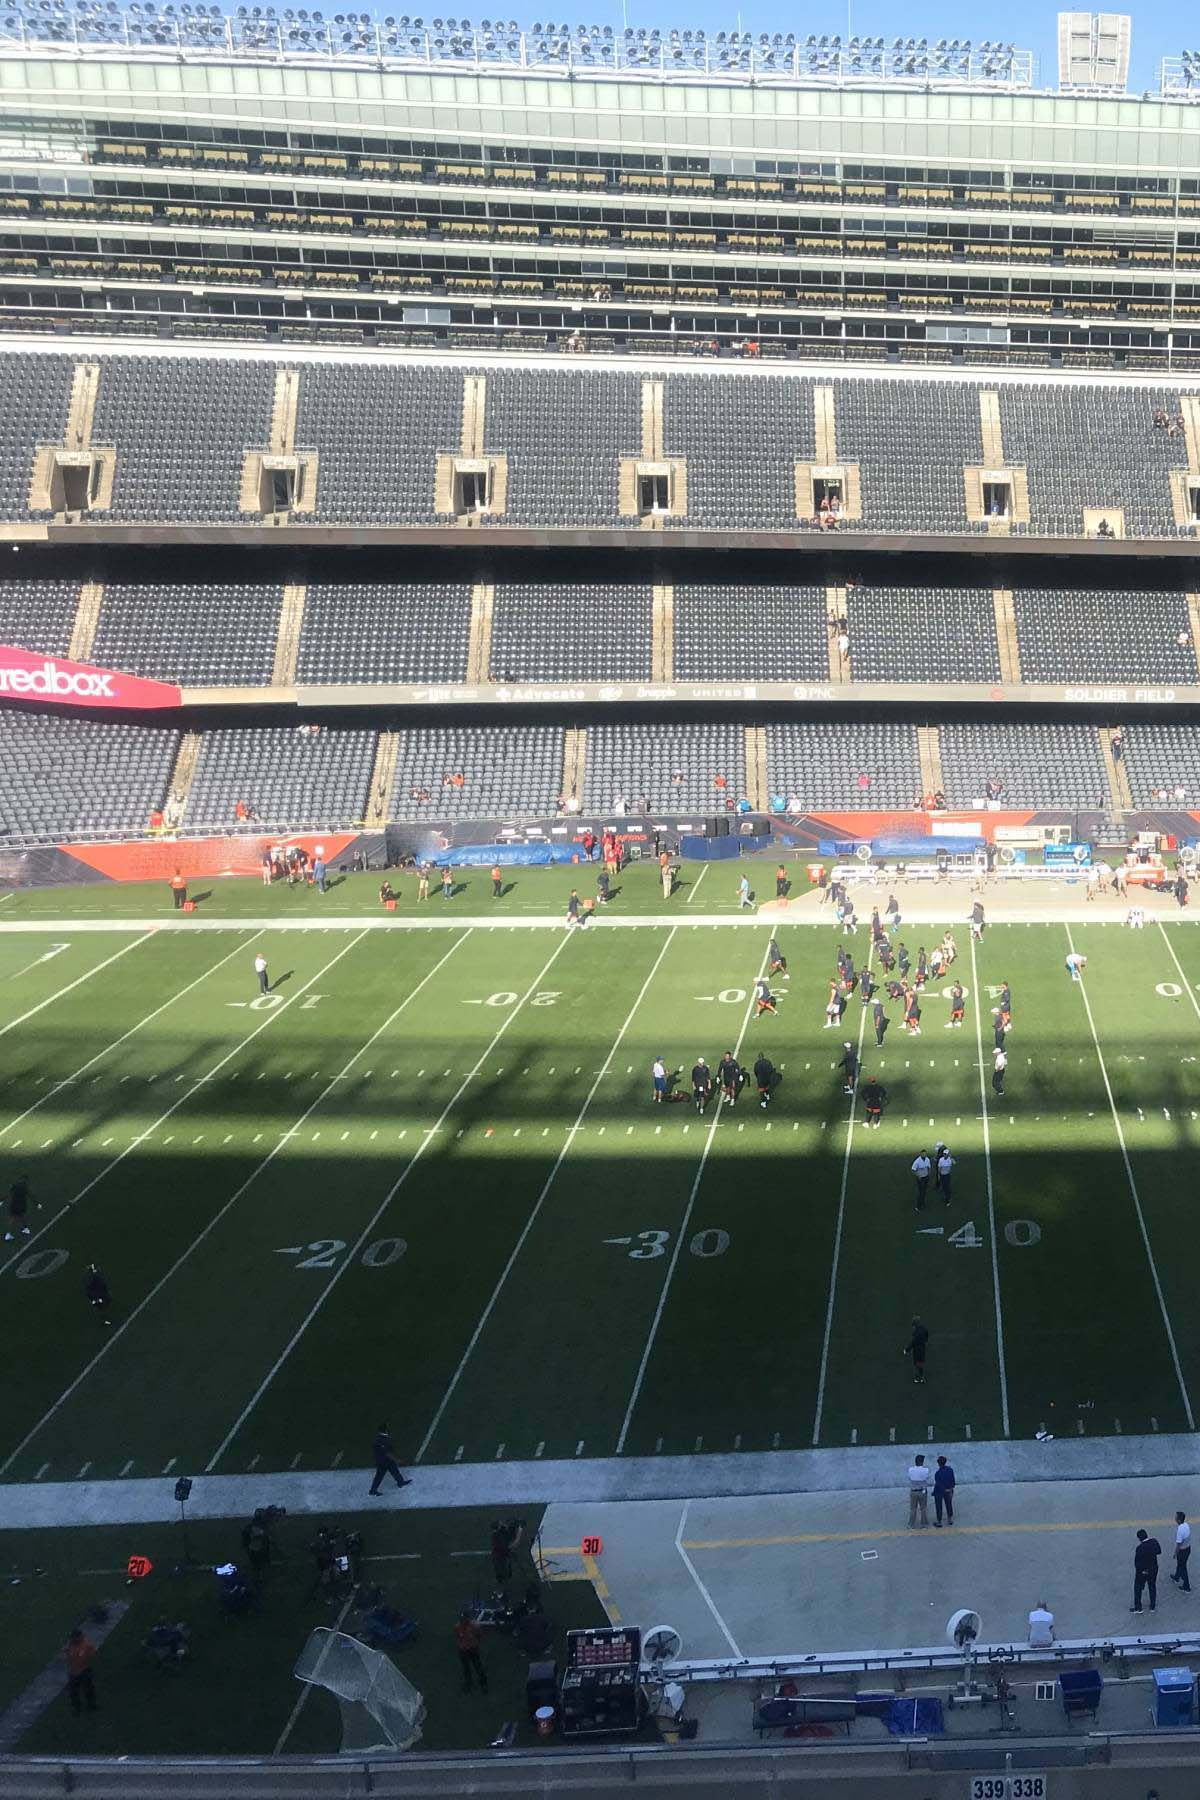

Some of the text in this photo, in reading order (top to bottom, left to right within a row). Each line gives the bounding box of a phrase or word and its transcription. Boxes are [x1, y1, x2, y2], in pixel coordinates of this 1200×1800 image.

[513, 687, 585, 699] Advocate
[693, 689, 741, 697] UNITED
[808, 687, 834, 698] PNC
[1064, 689, 1175, 702] SOLDIER FIELD
[583, 1538, 600, 1554] 30
[130, 1559, 145, 1575] 20
[974, 1778, 1043, 1799] 339 338
